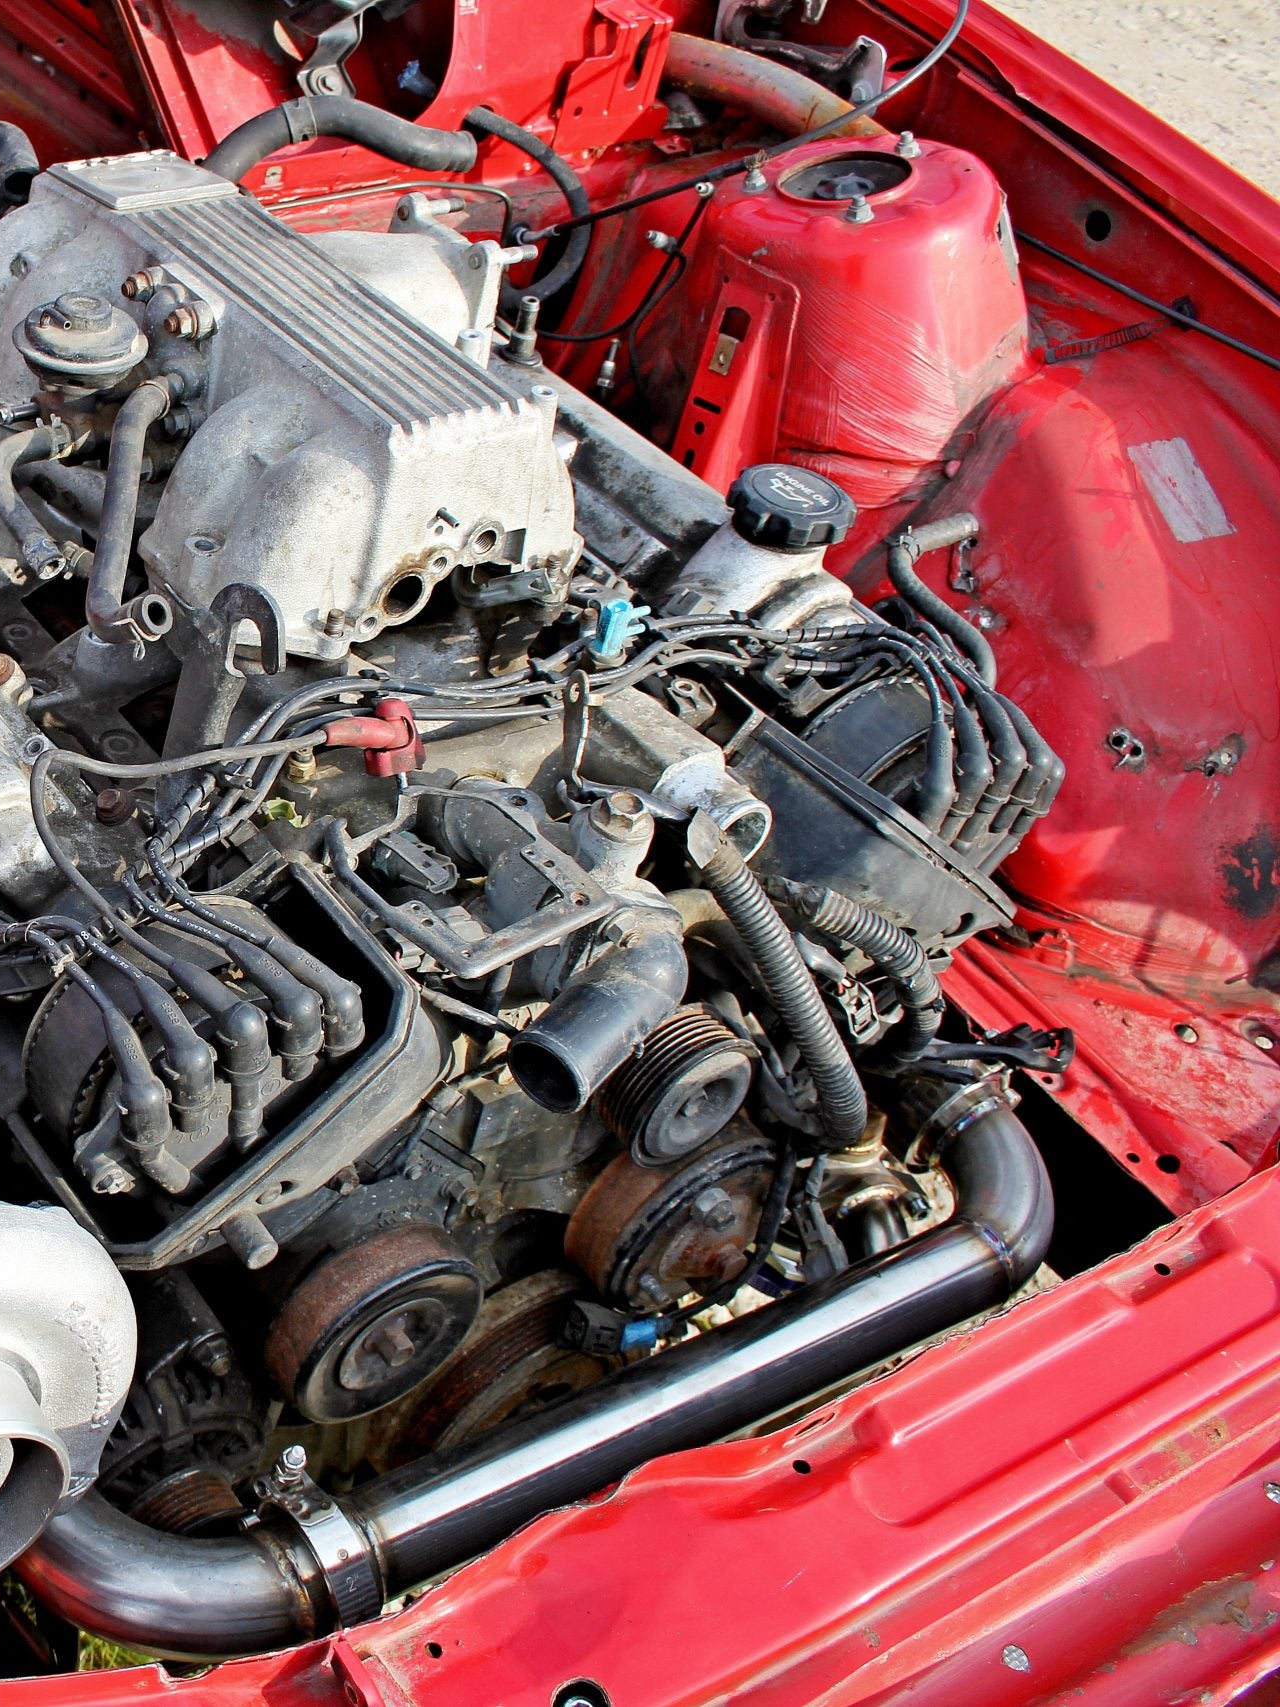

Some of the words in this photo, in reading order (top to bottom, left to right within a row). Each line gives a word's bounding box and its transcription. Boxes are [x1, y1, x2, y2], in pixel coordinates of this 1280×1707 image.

[775, 471, 816, 496] ENGINE
[812, 494, 831, 507] OIL
[186, 921, 212, 935] YAZAKI
